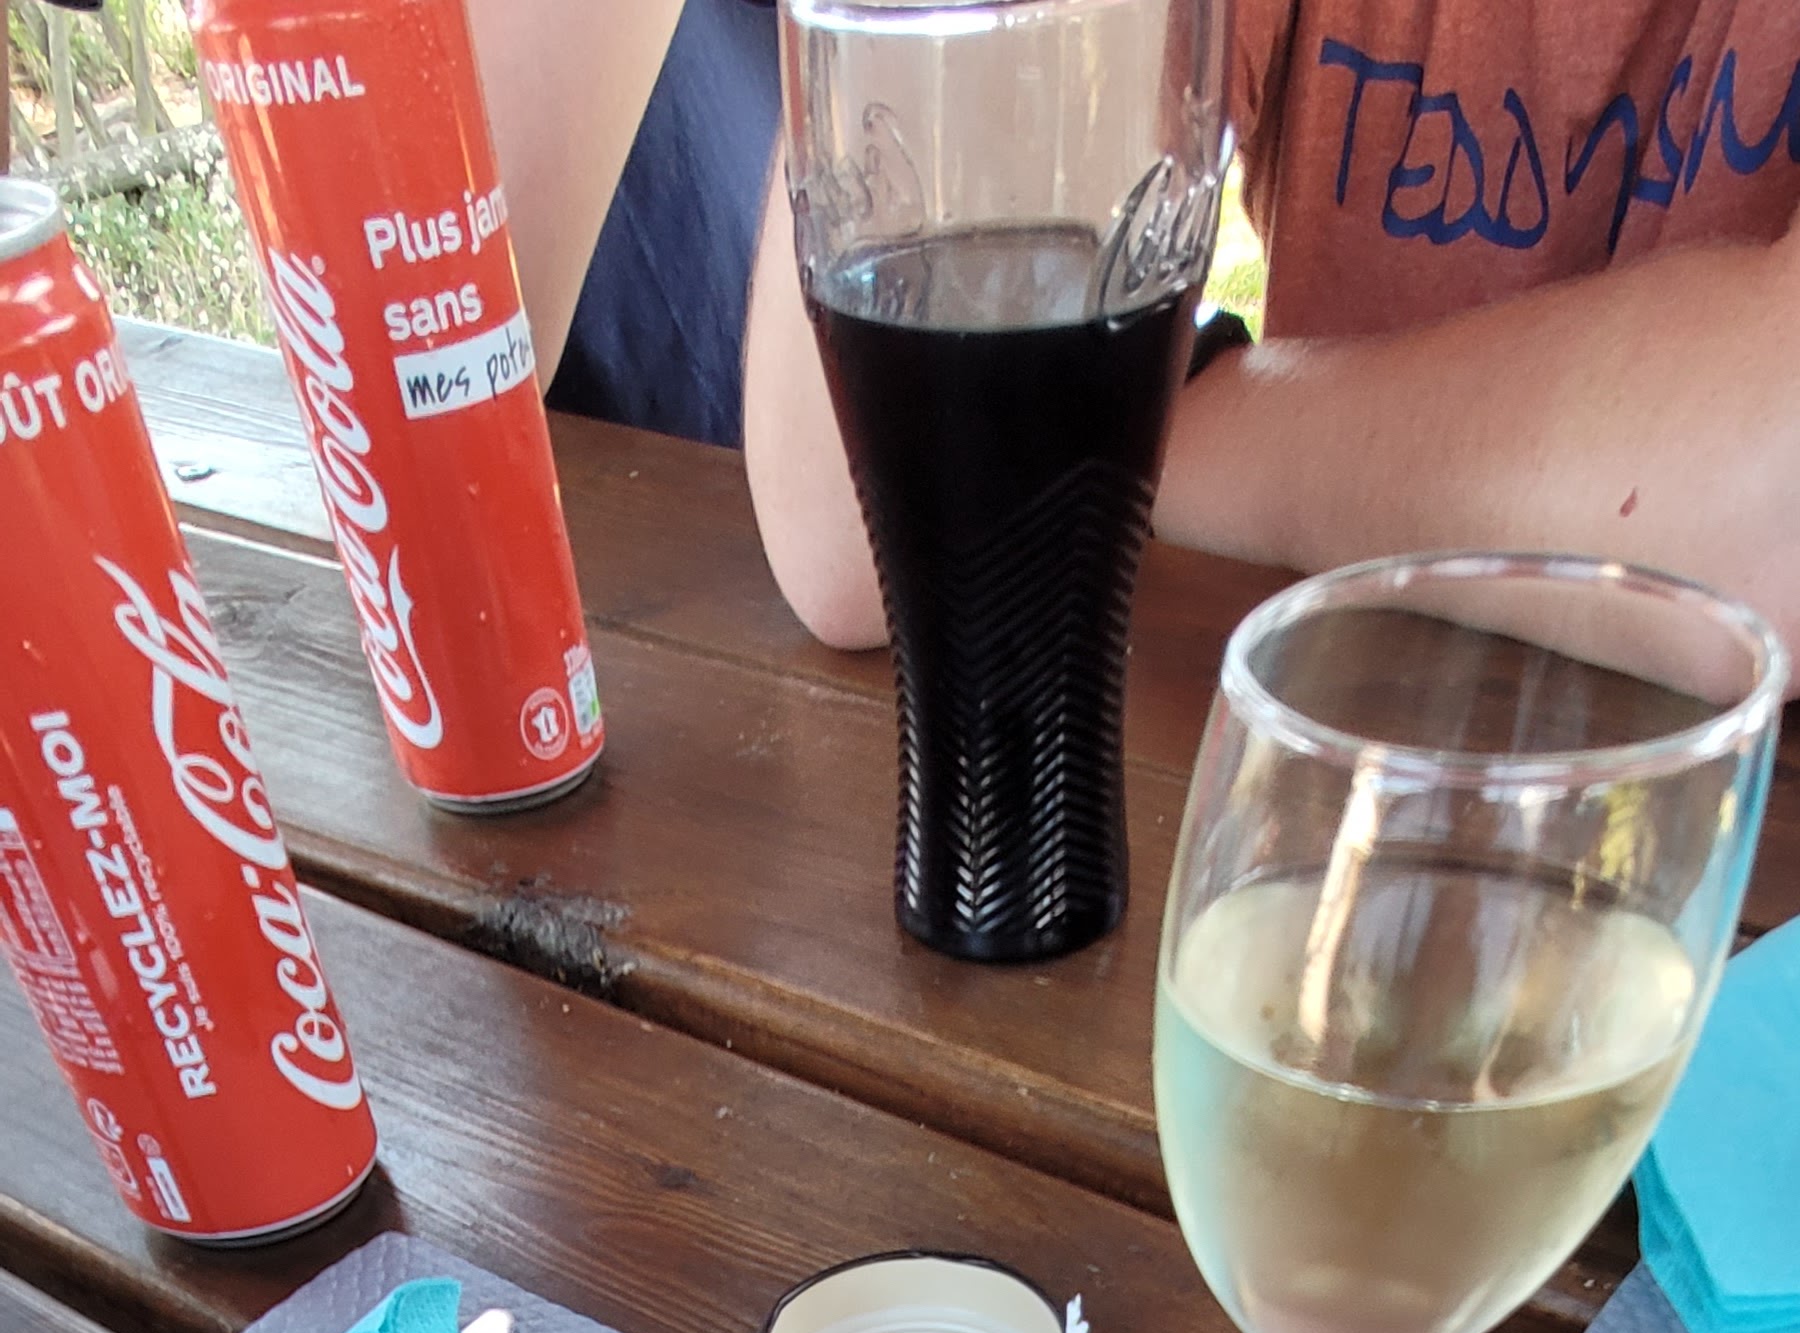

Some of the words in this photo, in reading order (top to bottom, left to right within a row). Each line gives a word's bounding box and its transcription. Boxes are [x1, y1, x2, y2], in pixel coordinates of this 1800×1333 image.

[204, 54, 367, 108] ORIGINAL
[363, 210, 463, 270] Plus
[383, 282, 483, 342] sans
[406, 365, 471, 409] mes
[30, 710, 217, 1101] RECYCLEZ-MOI
